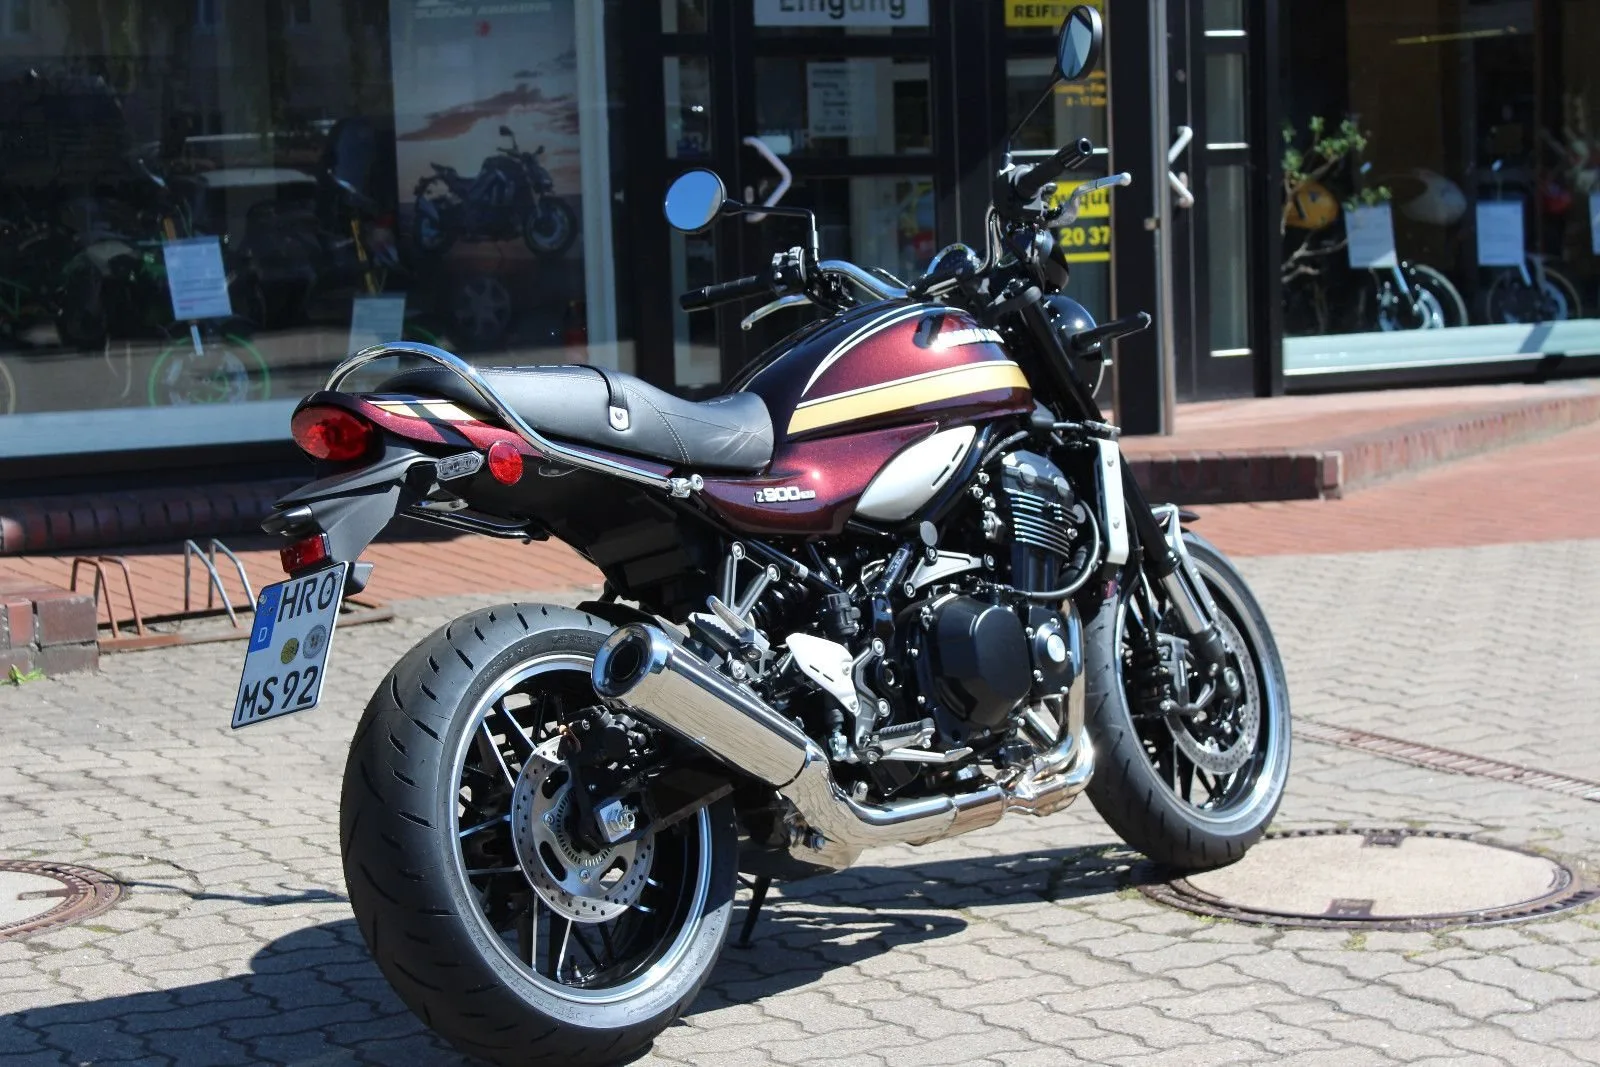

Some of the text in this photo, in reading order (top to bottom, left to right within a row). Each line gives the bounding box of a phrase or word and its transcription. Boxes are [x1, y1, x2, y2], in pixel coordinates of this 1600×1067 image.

[1060, 225, 1111, 247] 20 37
[277, 572, 336, 622] HRO
[257, 626, 268, 643] D
